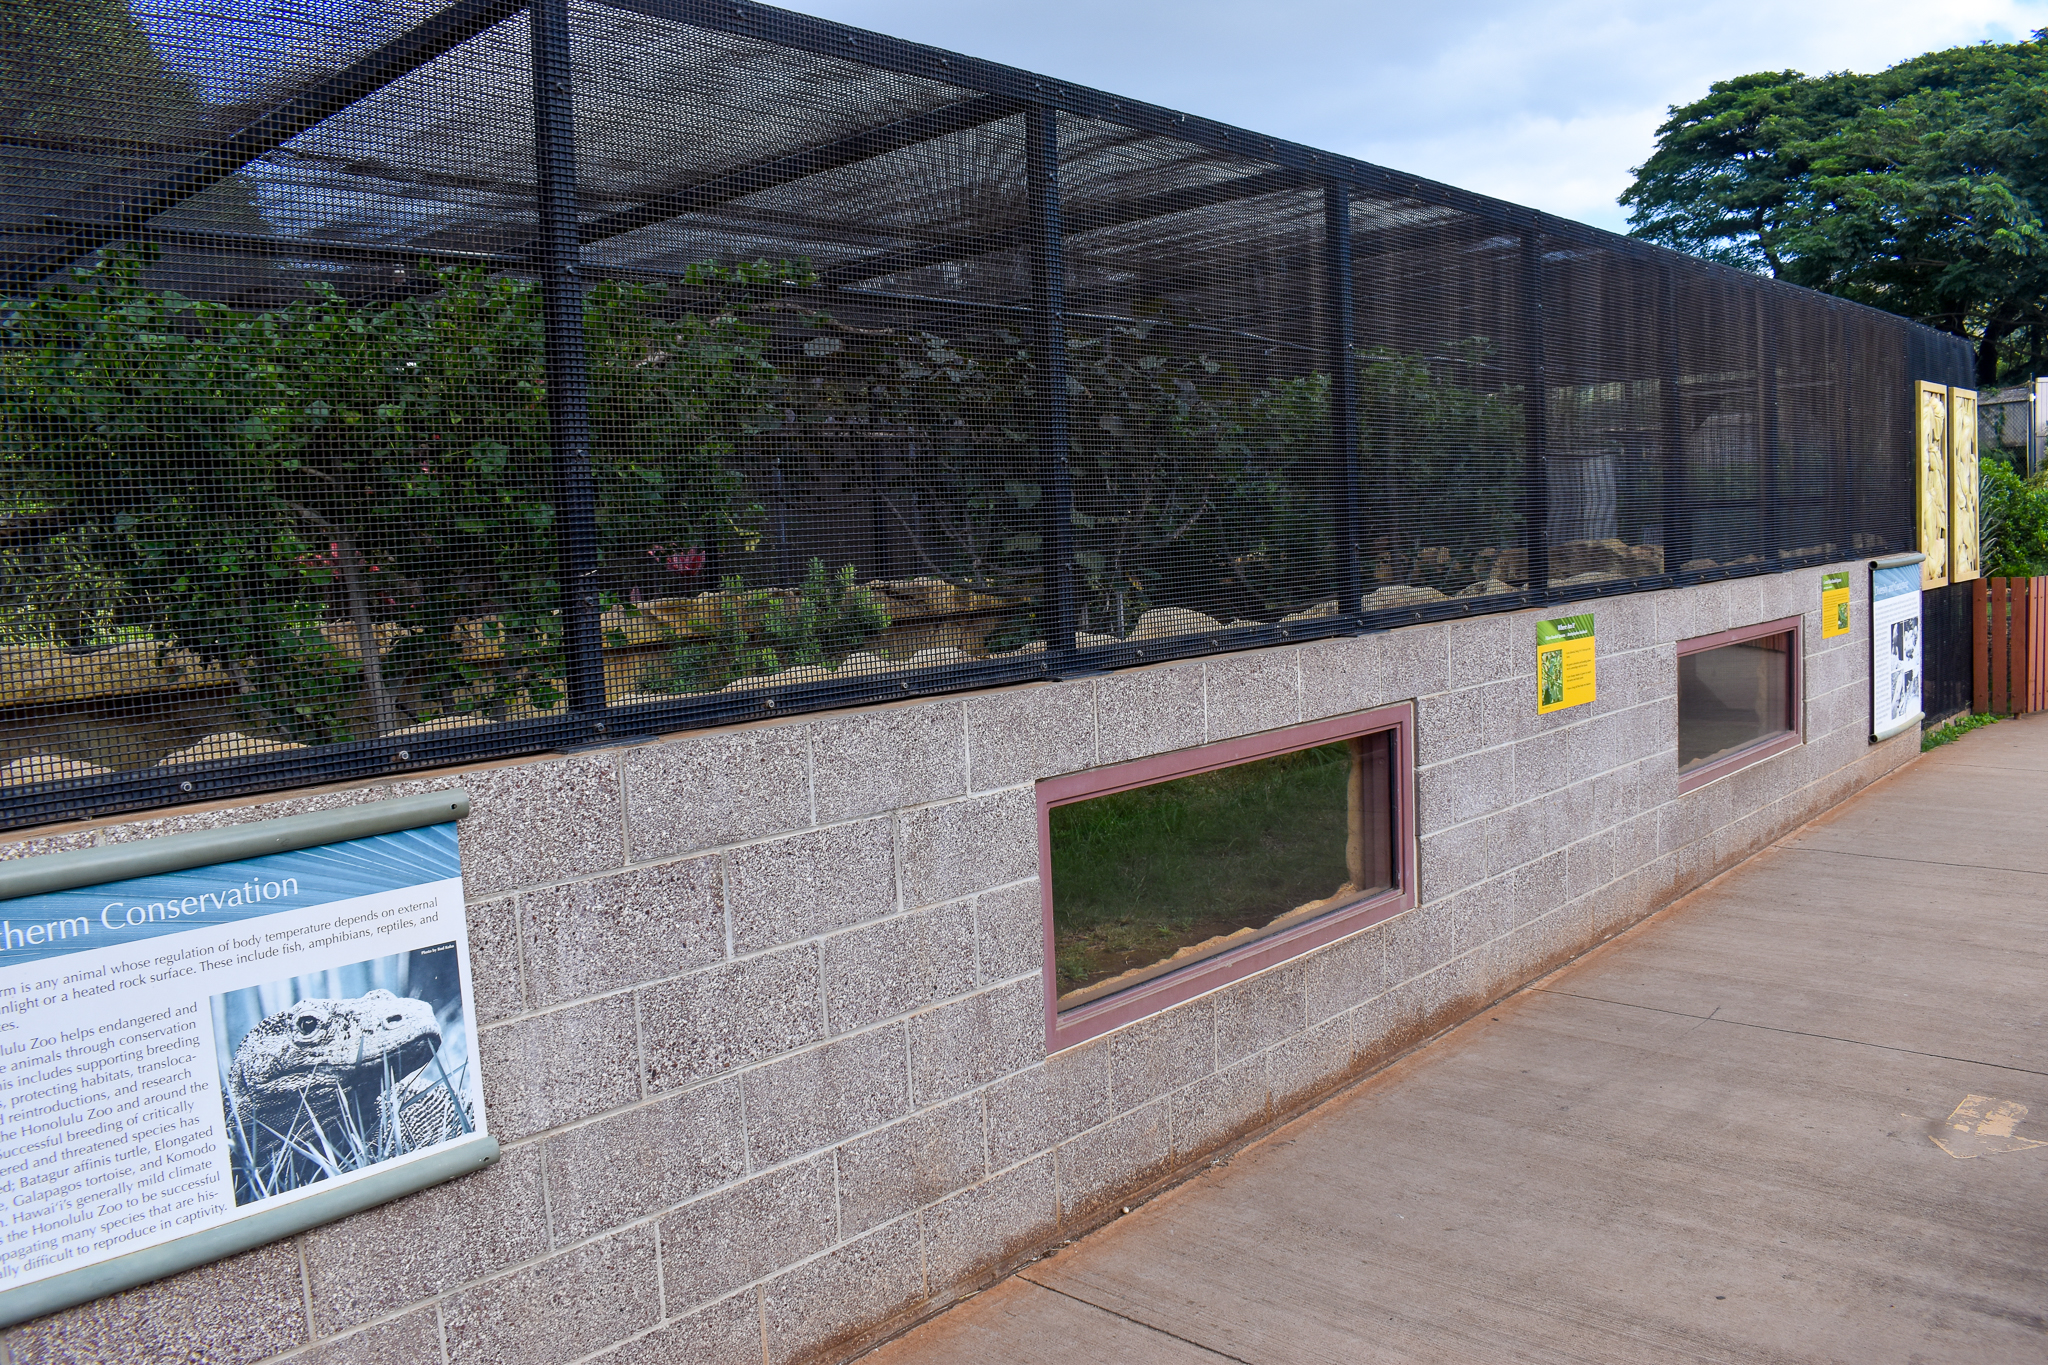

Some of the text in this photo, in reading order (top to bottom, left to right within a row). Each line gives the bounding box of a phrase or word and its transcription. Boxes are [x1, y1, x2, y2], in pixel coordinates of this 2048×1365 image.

[101, 876, 299, 930] Conservation
[20, 981, 32, 993] is
[34, 977, 59, 991] any
[62, 964, 107, 985] animal
[109, 958, 151, 974] whose
[153, 945, 215, 967] regulation
[217, 938, 230, 953] of
[231, 933, 262, 949] body
[264, 921, 332, 943] temperature
[333, 909, 379, 929] depends
[380, 908, 395, 918] on
[396, 896, 438, 915] external
[42, 994, 57, 1006] or
[60, 992, 69, 1002] a
[71, 978, 116, 1000] heated
[118, 973, 147, 990] rock
[149, 965, 197, 983] surface.
[198, 957, 233, 972] These
[235, 945, 280, 965] include
[281, 940, 305, 955] fish,
[307, 927, 374, 949] amphibians,
[376, 918, 417, 935] reptiles,
[418, 910, 439, 925] and
[10, 1049, 63, 1072] animals
[65, 1036, 115, 1059] through
[118, 1020, 197, 1046] conservation
[29, 1036, 57, 1050] Zoo
[59, 1027, 96, 1043] helps
[97, 1006, 172, 1034] endangered
[174, 1000, 198, 1017] and
[10, 1081, 78, 1109] protecting
[80, 1068, 134, 1089] habitats,
[136, 1053, 197, 1075] transloca-
[16, 1065, 73, 1087] includes
[75, 1049, 144, 1073] supporting
[145, 1035, 201, 1056] breeding
[8, 1091, 111, 1123] reintroductions,
[113, 1079, 138, 1097] and
[141, 1067, 192, 1090] research
[20, 1112, 84, 1137] Honolulu
[86, 1106, 113, 1121] Zoo
[116, 1095, 140, 1113] and
[143, 1083, 187, 1106] around
[189, 1081, 209, 1094] the
[65, 1119, 124, 1142] breeding
[125, 1111, 139, 1127] of
[141, 1099, 195, 1122] critically
[19, 1167, 70, 1189] Batagur
[73, 1154, 112, 1174] affinis
[114, 1144, 151, 1163] turtle,
[153, 1124, 213, 1152] Elongated
[32, 1150, 58, 1168] and
[60, 1131, 129, 1161] threatened
[131, 1121, 177, 1144] species
[178, 1115, 200, 1129] has
[12, 1180, 82, 1207] Galapagos
[84, 1166, 136, 1187] tortoise,
[139, 1154, 163, 1172] and
[165, 1141, 217, 1164] Komodo
[75, 1181, 134, 1210] generally
[136, 1169, 165, 1189] mild
[167, 1160, 212, 1180] climate
[6, 1229, 28, 1243] the
[31, 1209, 94, 1236] Honolulu
[96, 1202, 123, 1217] Zoo
[125, 1197, 139, 1208] to
[140, 1191, 158, 1203] be
[160, 1170, 220, 1198] successful
[60, 1226, 97, 1244] many
[100, 1211, 146, 1234] species
[148, 1202, 172, 1218] that
[174, 1197, 194, 1210] are
[196, 1189, 219, 1203] his-
[23, 1247, 73, 1272] difficult
[76, 1245, 90, 1256] to
[92, 1224, 157, 1251] reproduce
[159, 1219, 172, 1230] in
[174, 1203, 228, 1226] captivity.
